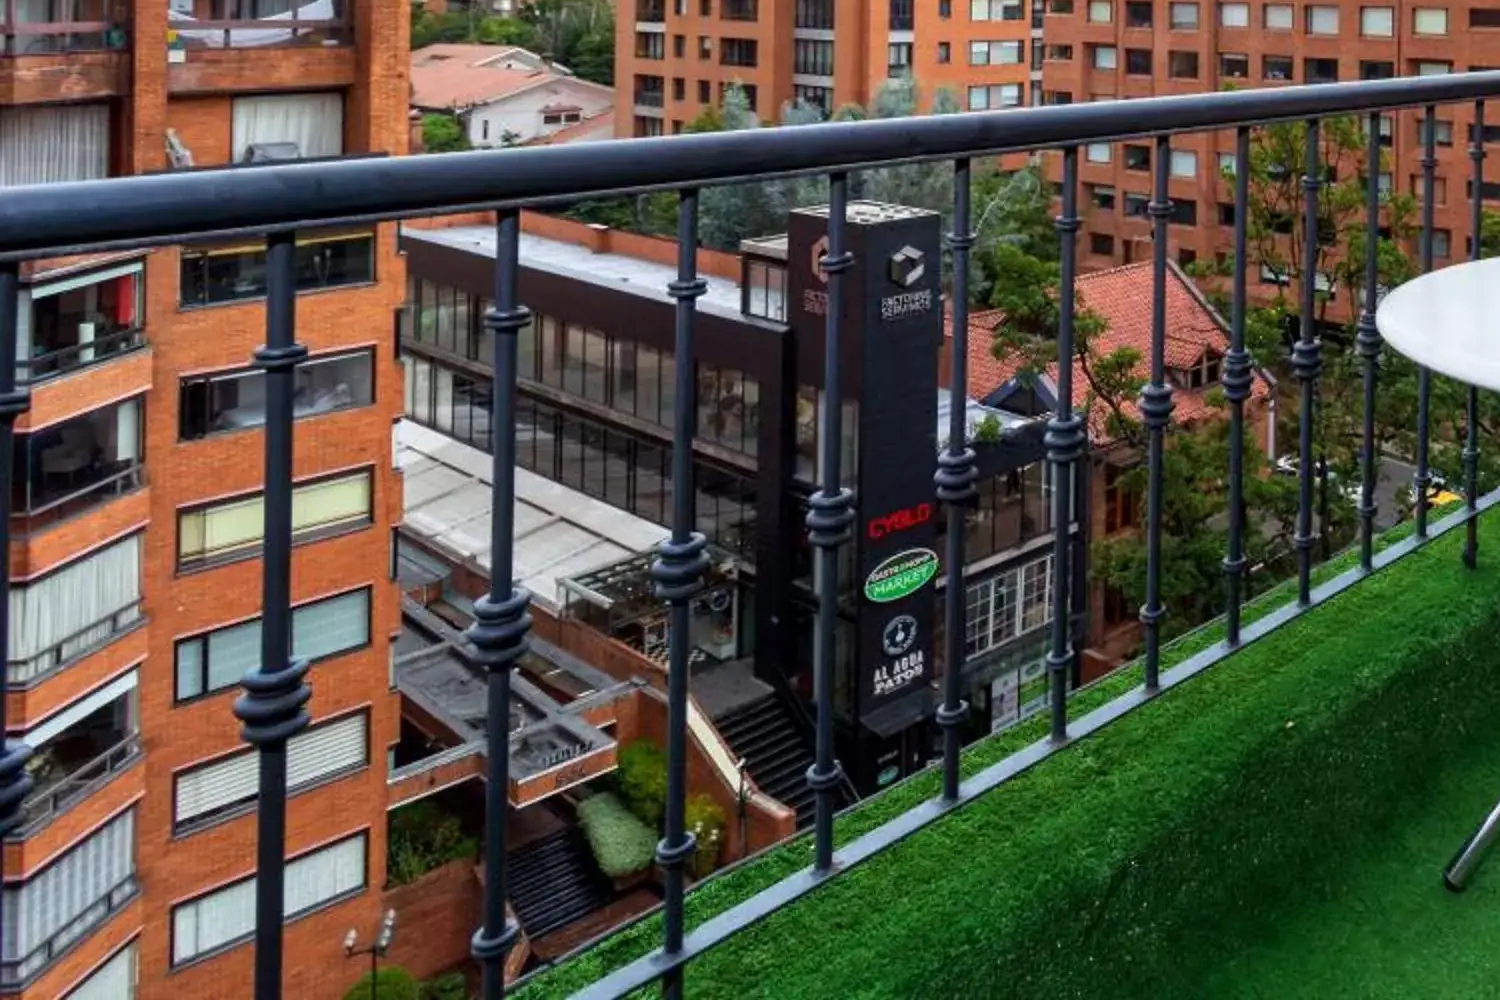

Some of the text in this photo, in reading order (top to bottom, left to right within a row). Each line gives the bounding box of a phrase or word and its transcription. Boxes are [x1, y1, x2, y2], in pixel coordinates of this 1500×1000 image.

[872, 566, 929, 597] MARKET
[873, 650, 923, 683] AL AGUA
[873, 663, 923, 695] PATOS
